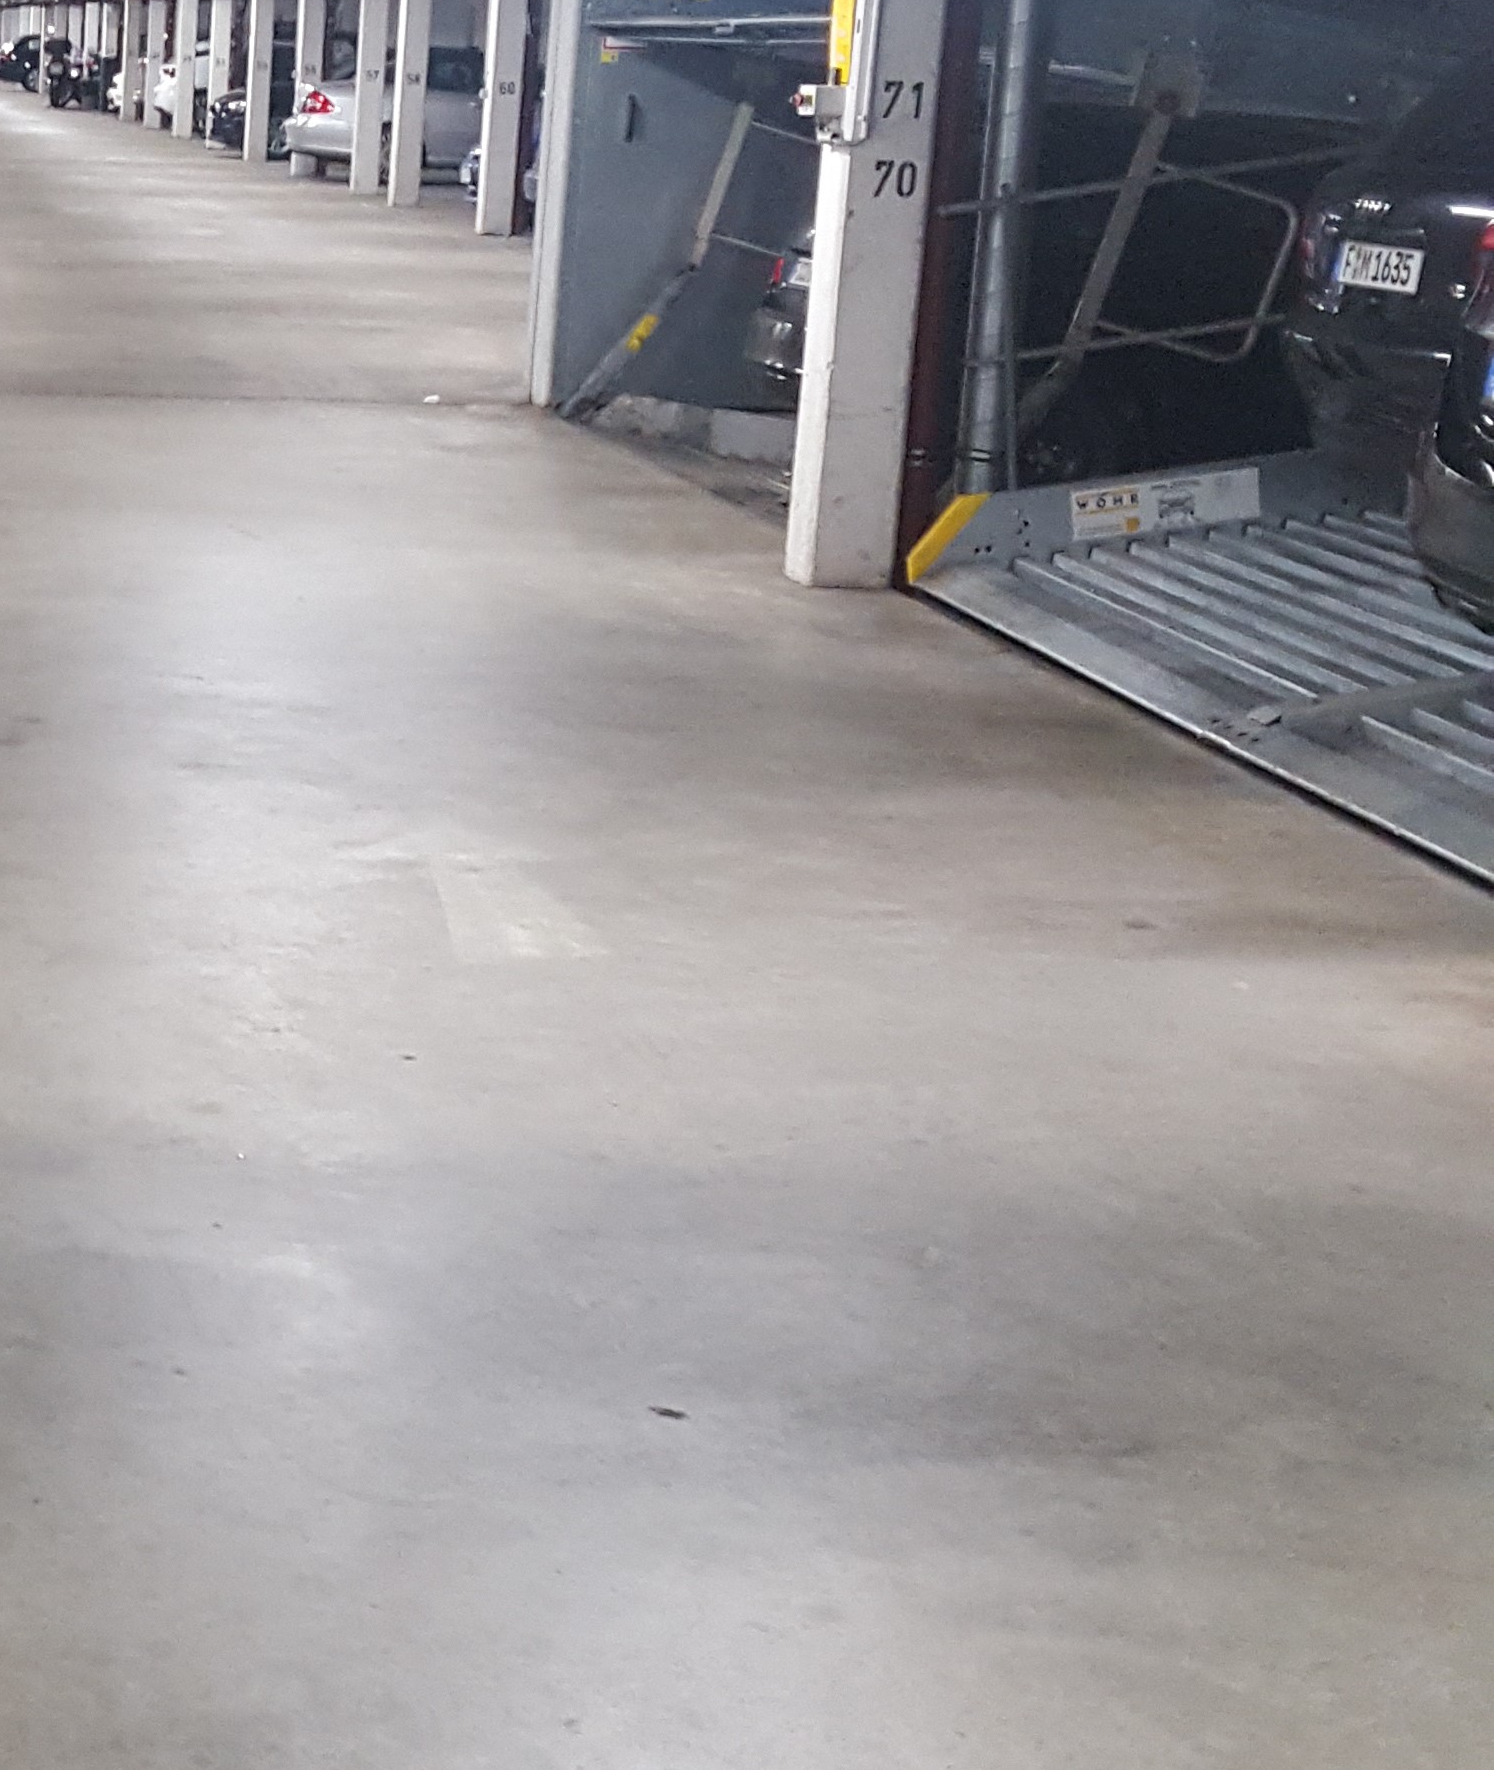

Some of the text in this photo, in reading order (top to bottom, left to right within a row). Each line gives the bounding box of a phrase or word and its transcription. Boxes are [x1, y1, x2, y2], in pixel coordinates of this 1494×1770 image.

[499, 81, 515, 95] 60
[882, 81, 924, 118] 71
[874, 160, 917, 198] 70
